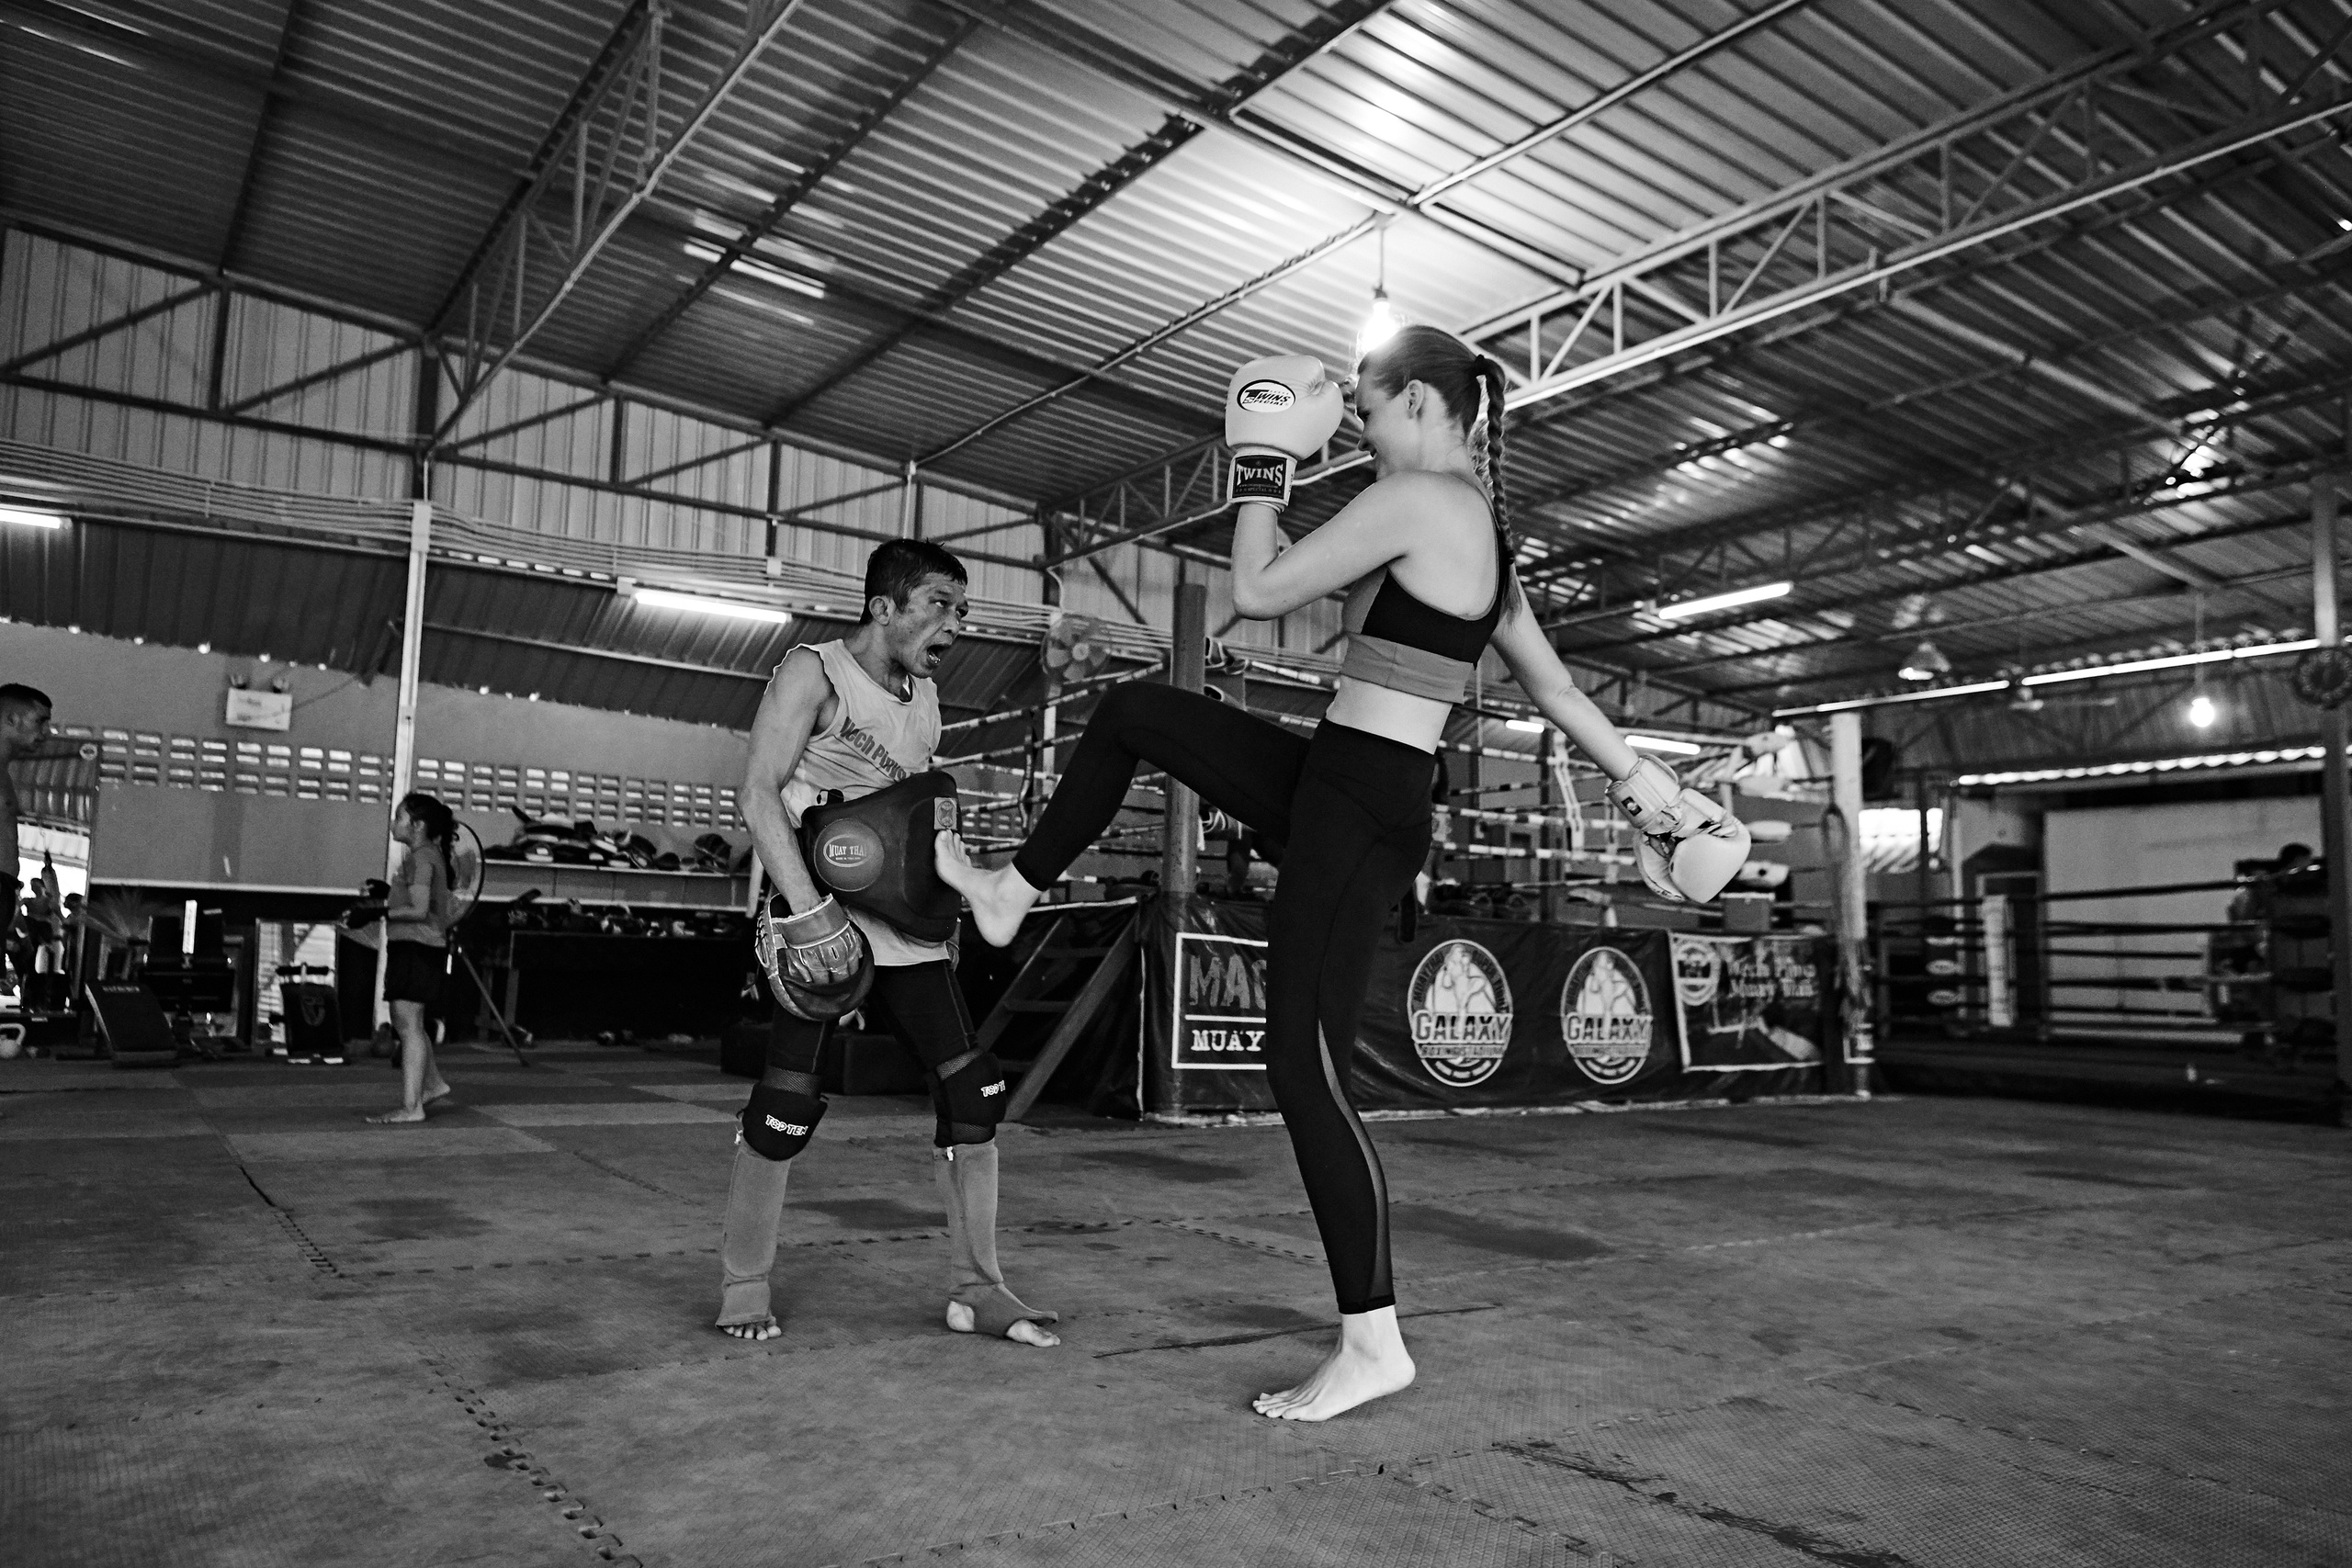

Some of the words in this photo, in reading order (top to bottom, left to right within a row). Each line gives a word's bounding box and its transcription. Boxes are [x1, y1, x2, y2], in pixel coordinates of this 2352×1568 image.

[1242, 396, 1283, 406] SPECIAL
[1244, 389, 1291, 402] TWINS
[1236, 463, 1283, 487] TWINS
[829, 843, 847, 858] MUAY
[849, 843, 867, 857] THAI
[1415, 1011, 1510, 1041] GALAXY
[1567, 1015, 1648, 1040] GALAXY
[1191, 1029, 1266, 1052] MUAY
[980, 1083, 999, 1098] TOP
[765, 1114, 787, 1132] TOP
[786, 1123, 808, 1135] TEN
